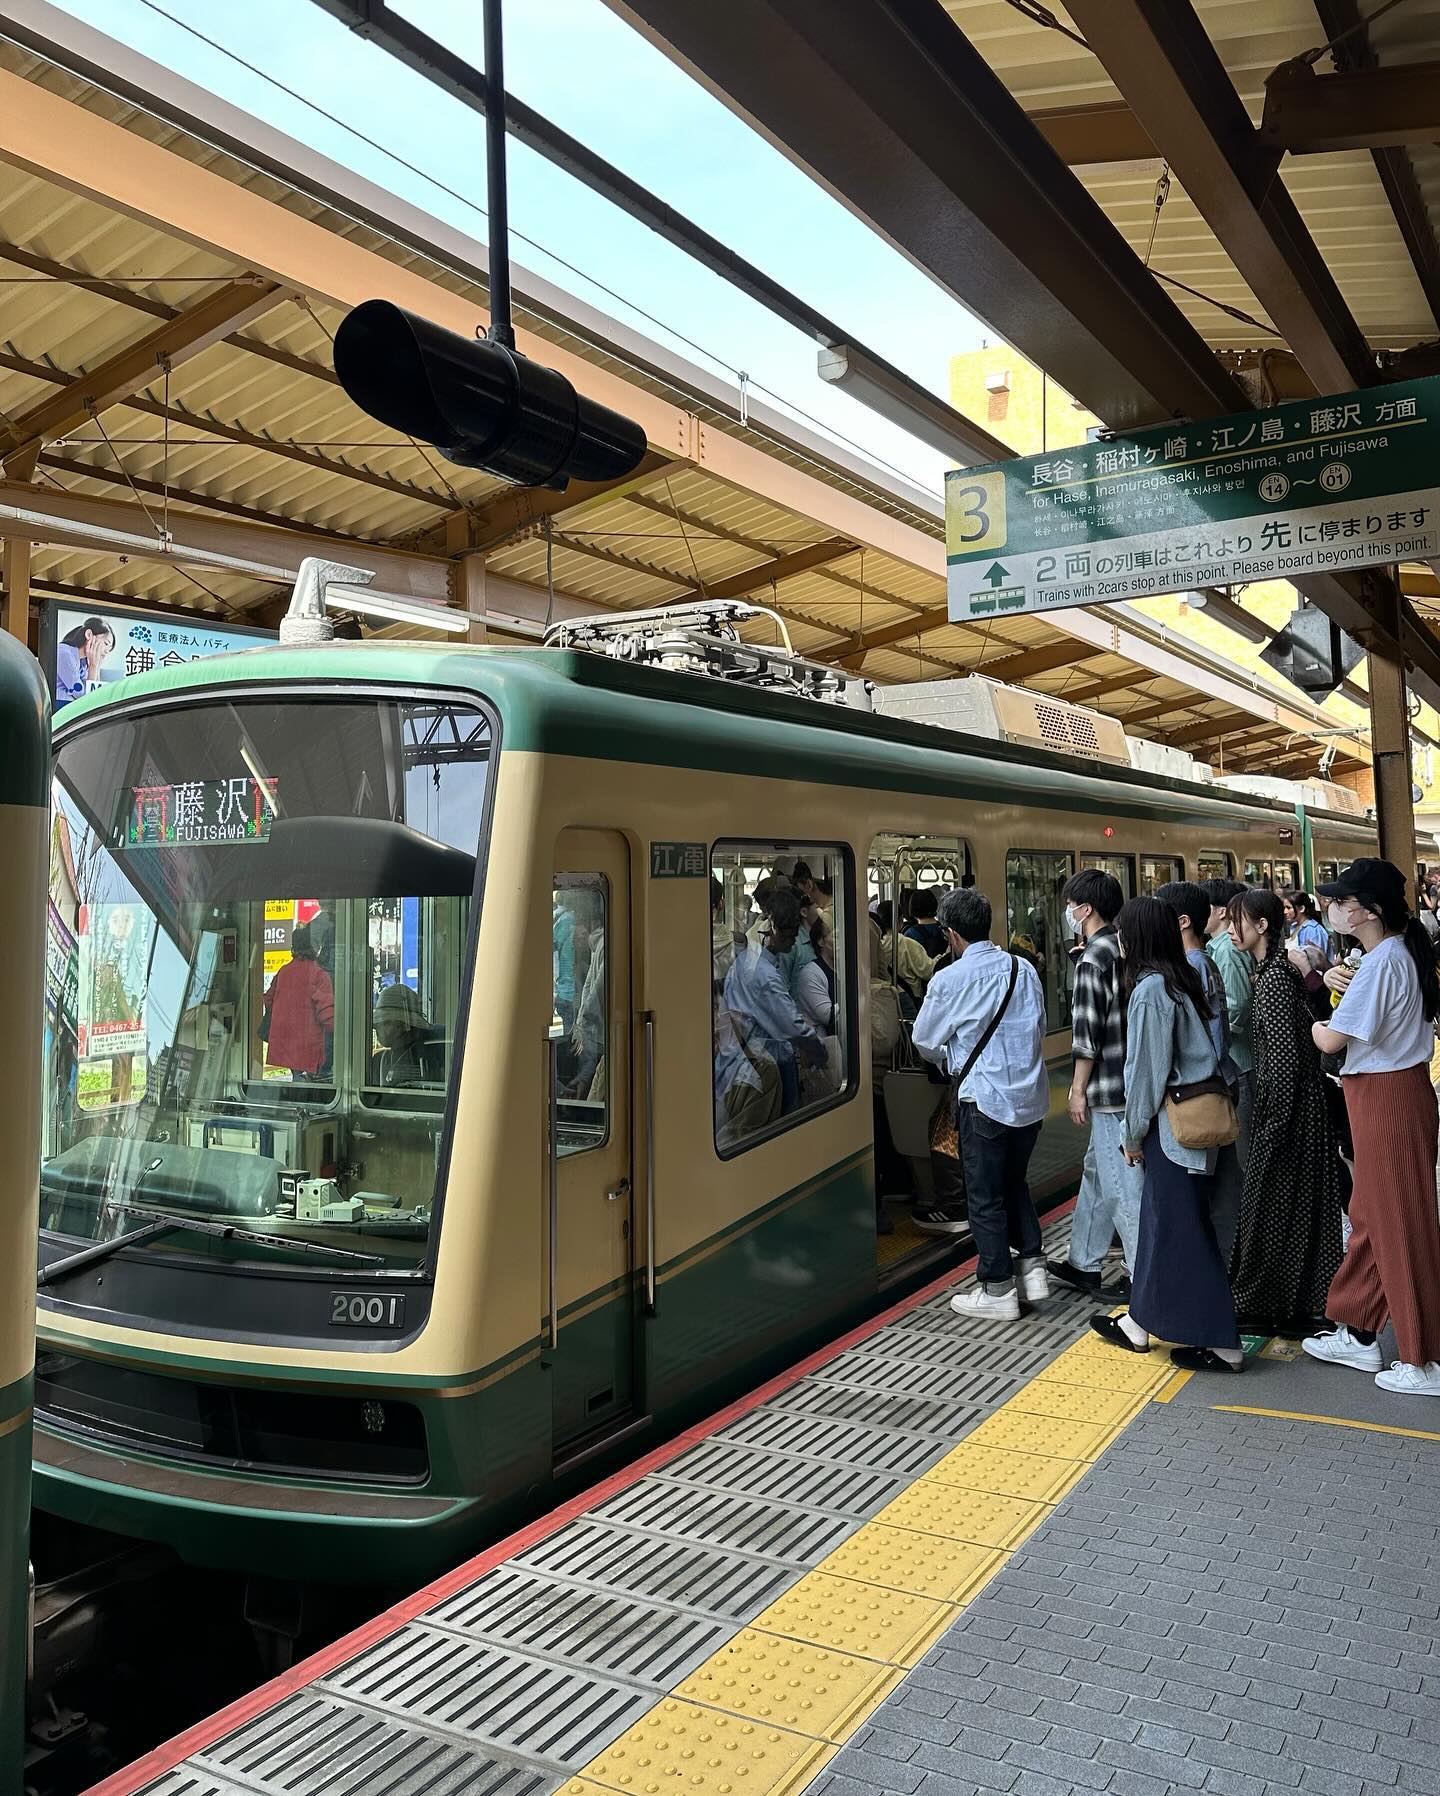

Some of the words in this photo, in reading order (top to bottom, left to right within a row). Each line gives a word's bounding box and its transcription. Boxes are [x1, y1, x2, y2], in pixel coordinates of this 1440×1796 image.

[1375, 397, 1417, 422] 方面
[1033, 496, 1050, 508] for
[1054, 490, 1091, 505] Hase,
[1096, 467, 1200, 497] Inamuragasaki,
[1205, 455, 1281, 478] Enoshima,
[1286, 447, 1315, 463] and
[1320, 436, 1389, 458] Fujisawa
[1265, 484, 1284, 497] 14
[1326, 473, 1343, 487] 01
[1267, 476, 1280, 484] EN
[960, 486, 990, 542] 3
[1038, 588, 1071, 603] Trains
[1073, 583, 1095, 598] with
[1097, 579, 1129, 595] 2cars
[1131, 576, 1155, 592] stop
[1158, 573, 1170, 586] at
[1173, 569, 1193, 584] this
[1197, 564, 1229, 585] point.
[1233, 559, 1274, 577] Please
[1277, 552, 1314, 569] board
[1317, 544, 1364, 565] beyond
[1368, 541, 1392, 557] this
[1395, 536, 1432, 557] point.
[158, 632, 200, 647] 医療法人
[173, 778, 249, 827] 藤沢
[176, 824, 246, 841] FUJISAWA
[332, 1296, 396, 1325] 2001
